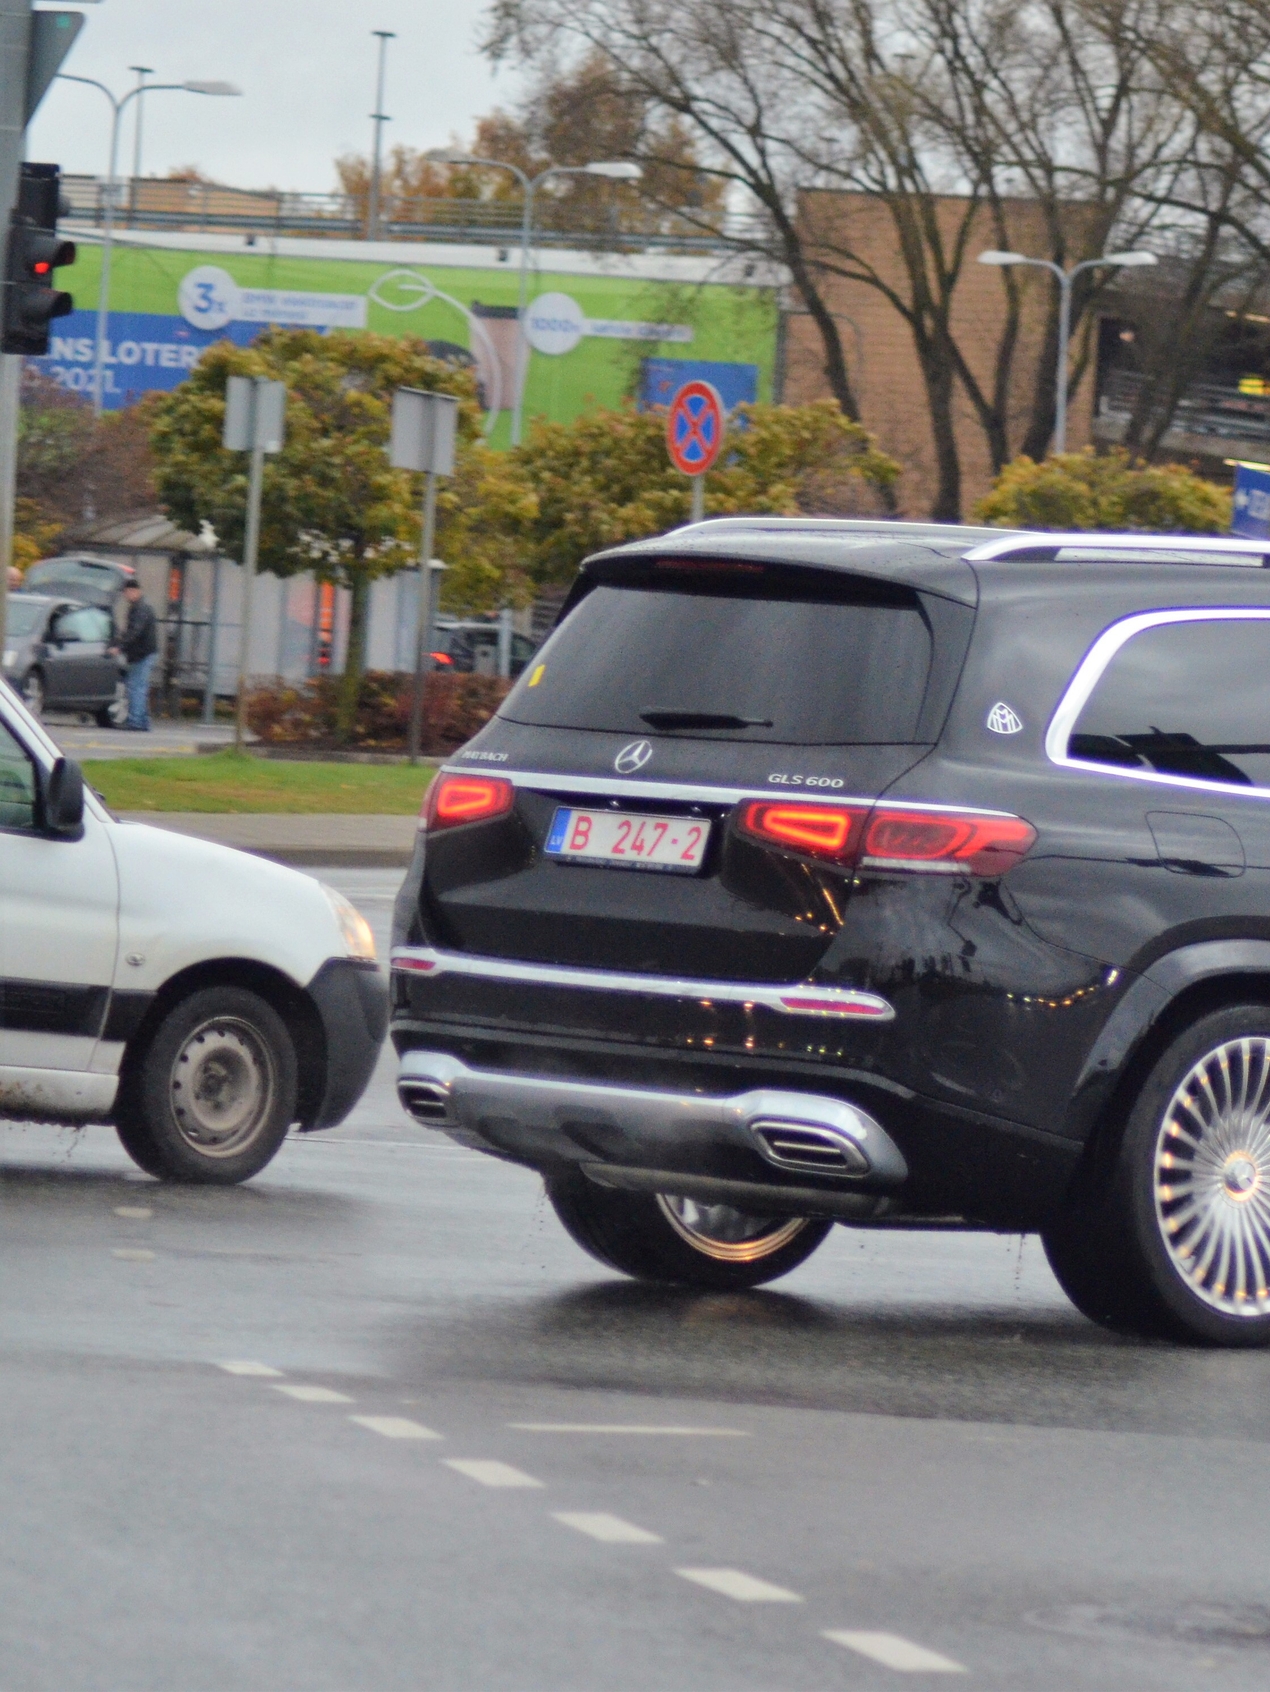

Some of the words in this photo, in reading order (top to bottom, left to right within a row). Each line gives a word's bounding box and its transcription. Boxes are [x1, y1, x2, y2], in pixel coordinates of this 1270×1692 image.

[768, 773, 804, 785] GLS
[805, 776, 844, 788] 600
[568, 815, 593, 851] B
[611, 819, 702, 861] 247-2
